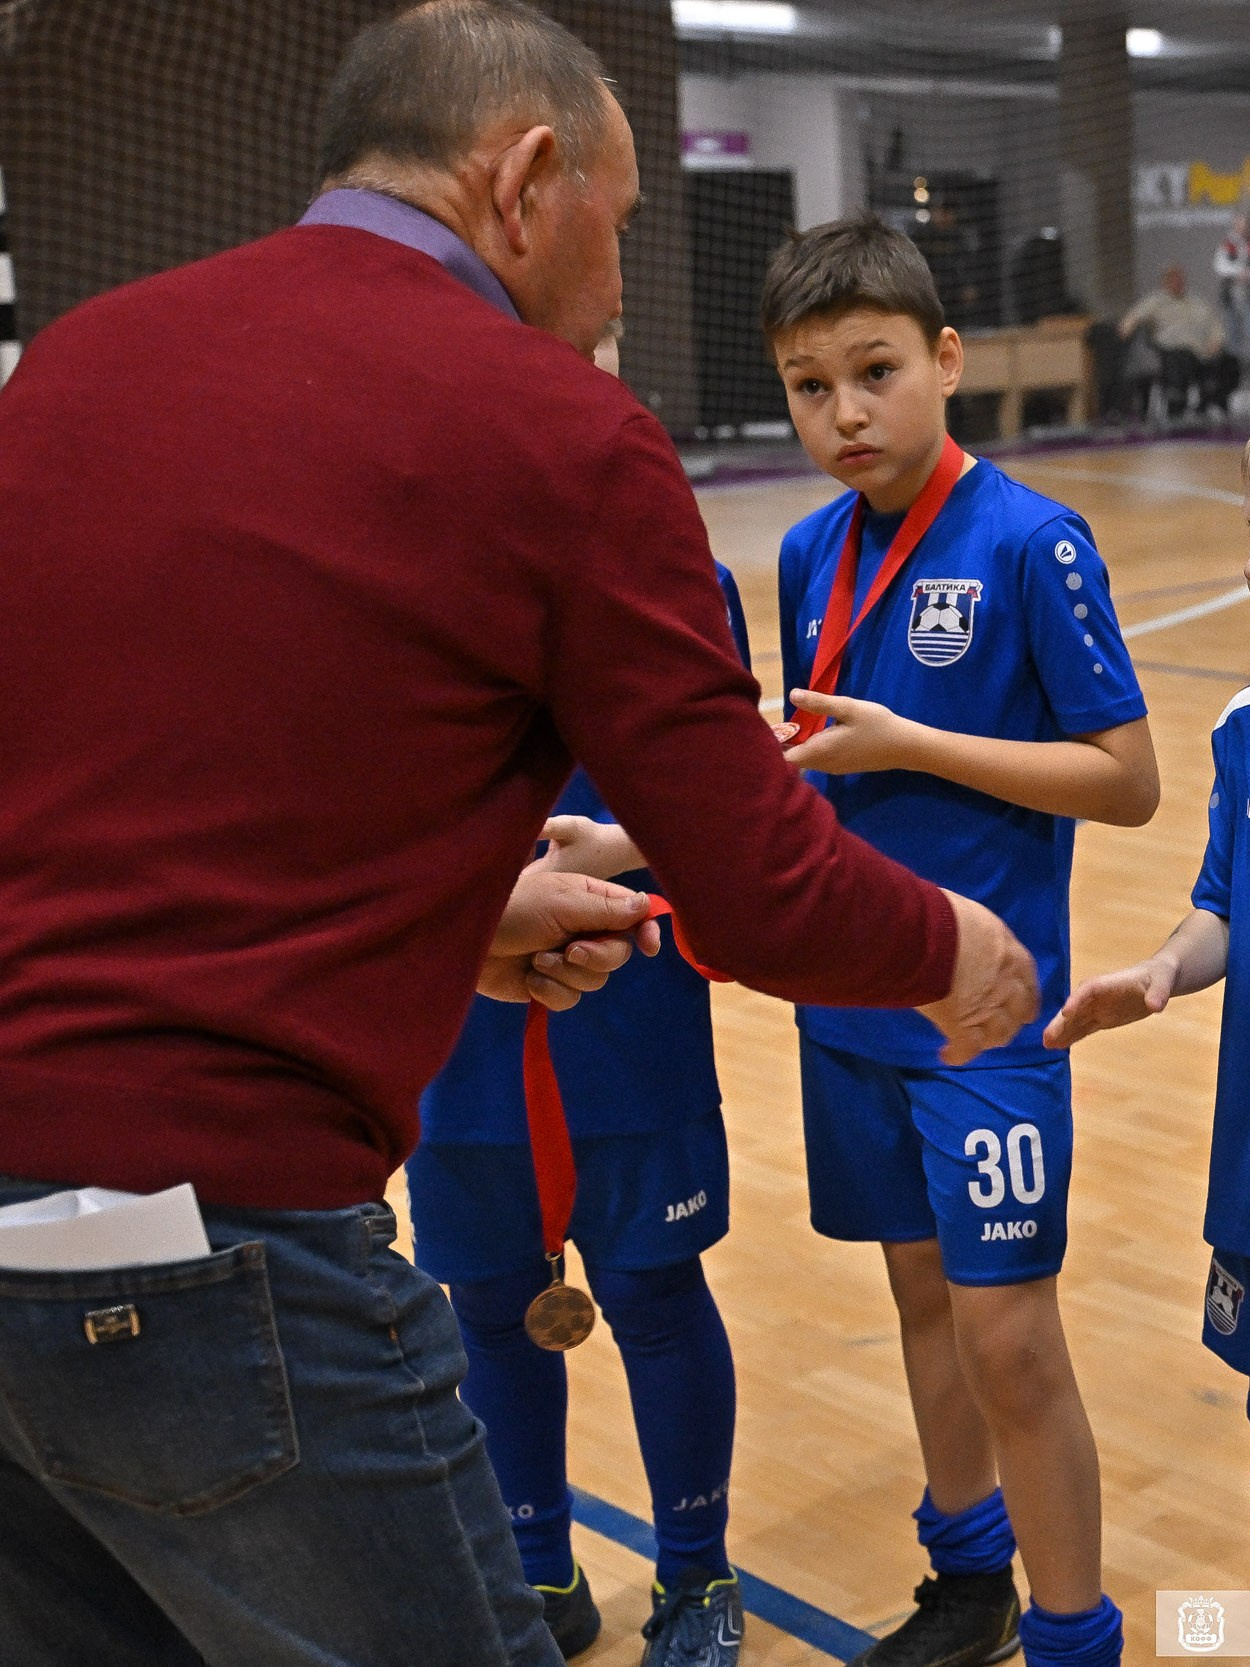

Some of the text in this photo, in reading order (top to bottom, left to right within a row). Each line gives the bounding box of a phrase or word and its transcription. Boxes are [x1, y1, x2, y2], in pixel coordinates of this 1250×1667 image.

[925, 583, 967, 592] БАЛТИКА
[964, 1123, 1046, 1209] 30
[665, 1189, 707, 1223] JAKO
[981, 1220, 1038, 1241] JAKO
